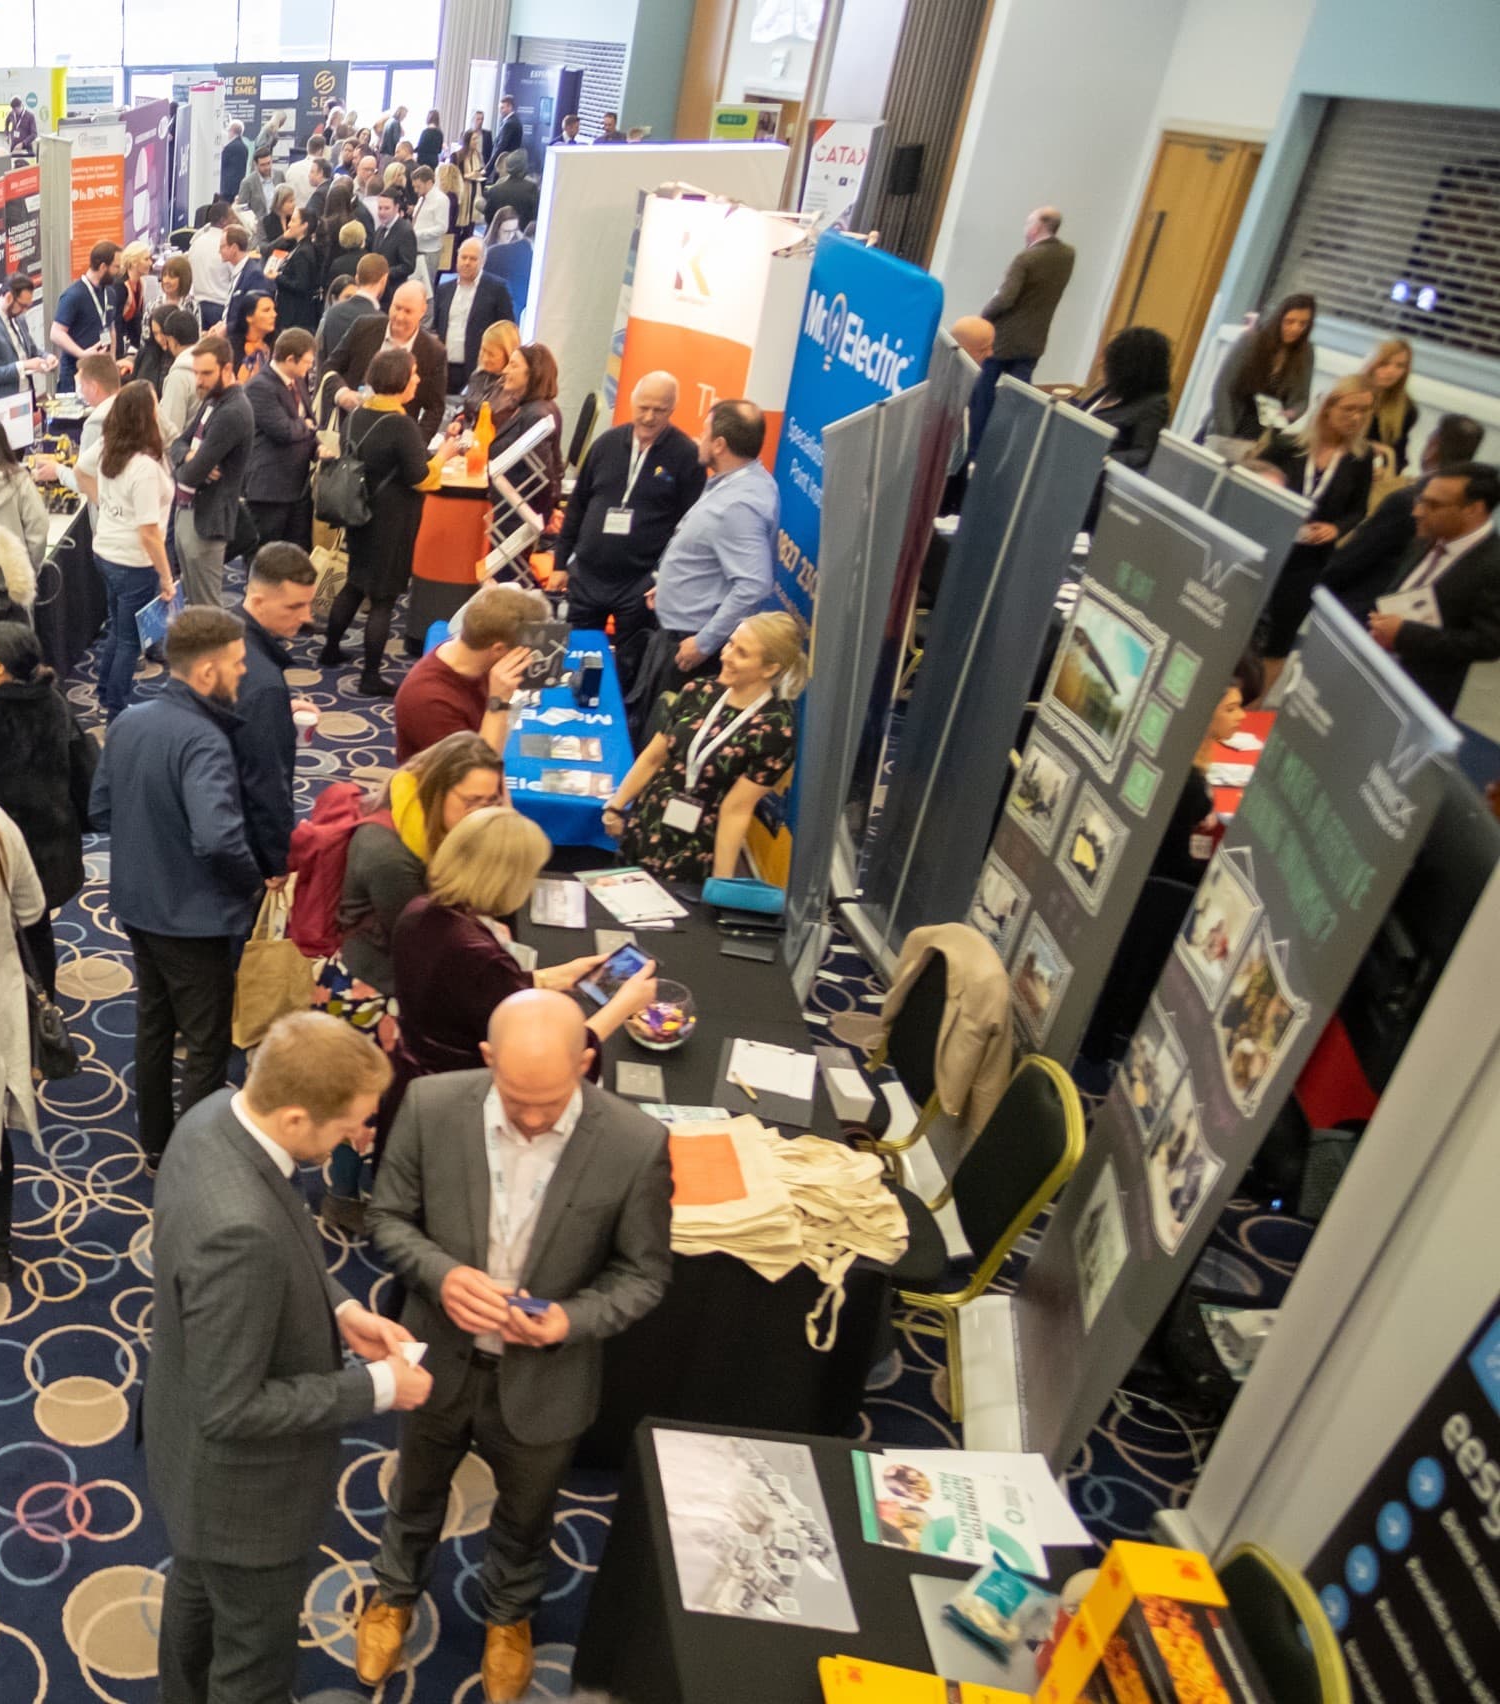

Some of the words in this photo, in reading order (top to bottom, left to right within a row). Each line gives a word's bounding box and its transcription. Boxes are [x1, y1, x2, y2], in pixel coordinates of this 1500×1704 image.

[235, 76, 256, 85] CRM
[938, 1471, 952, 1501] PACK
[963, 1476, 984, 1541] EXHIBITOR
[951, 1474, 975, 1557] INFORMATION
